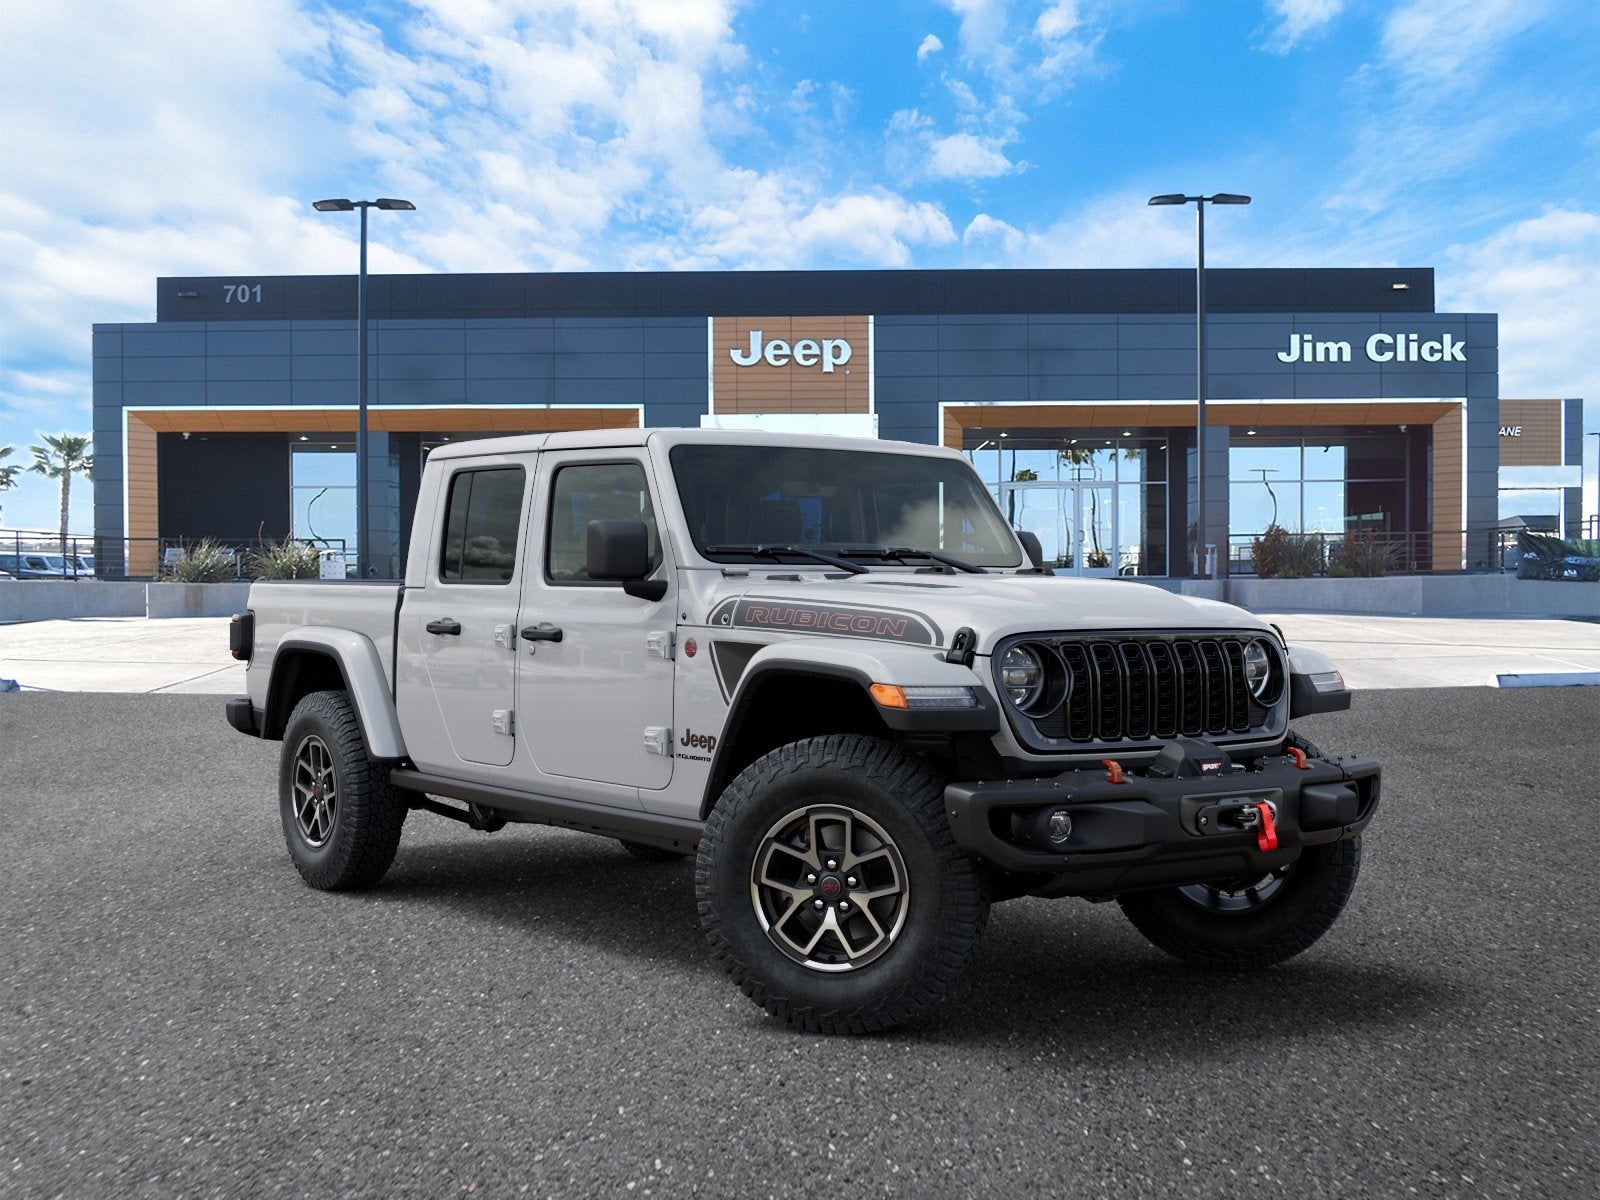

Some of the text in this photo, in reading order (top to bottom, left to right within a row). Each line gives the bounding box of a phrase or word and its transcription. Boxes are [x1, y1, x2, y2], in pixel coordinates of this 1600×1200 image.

[223, 284, 262, 304] 701
[729, 330, 852, 373] Jeep
[1277, 333, 1467, 363] Jim Click
[745, 606, 908, 637] RUBICON
[680, 728, 717, 754] Jeep
